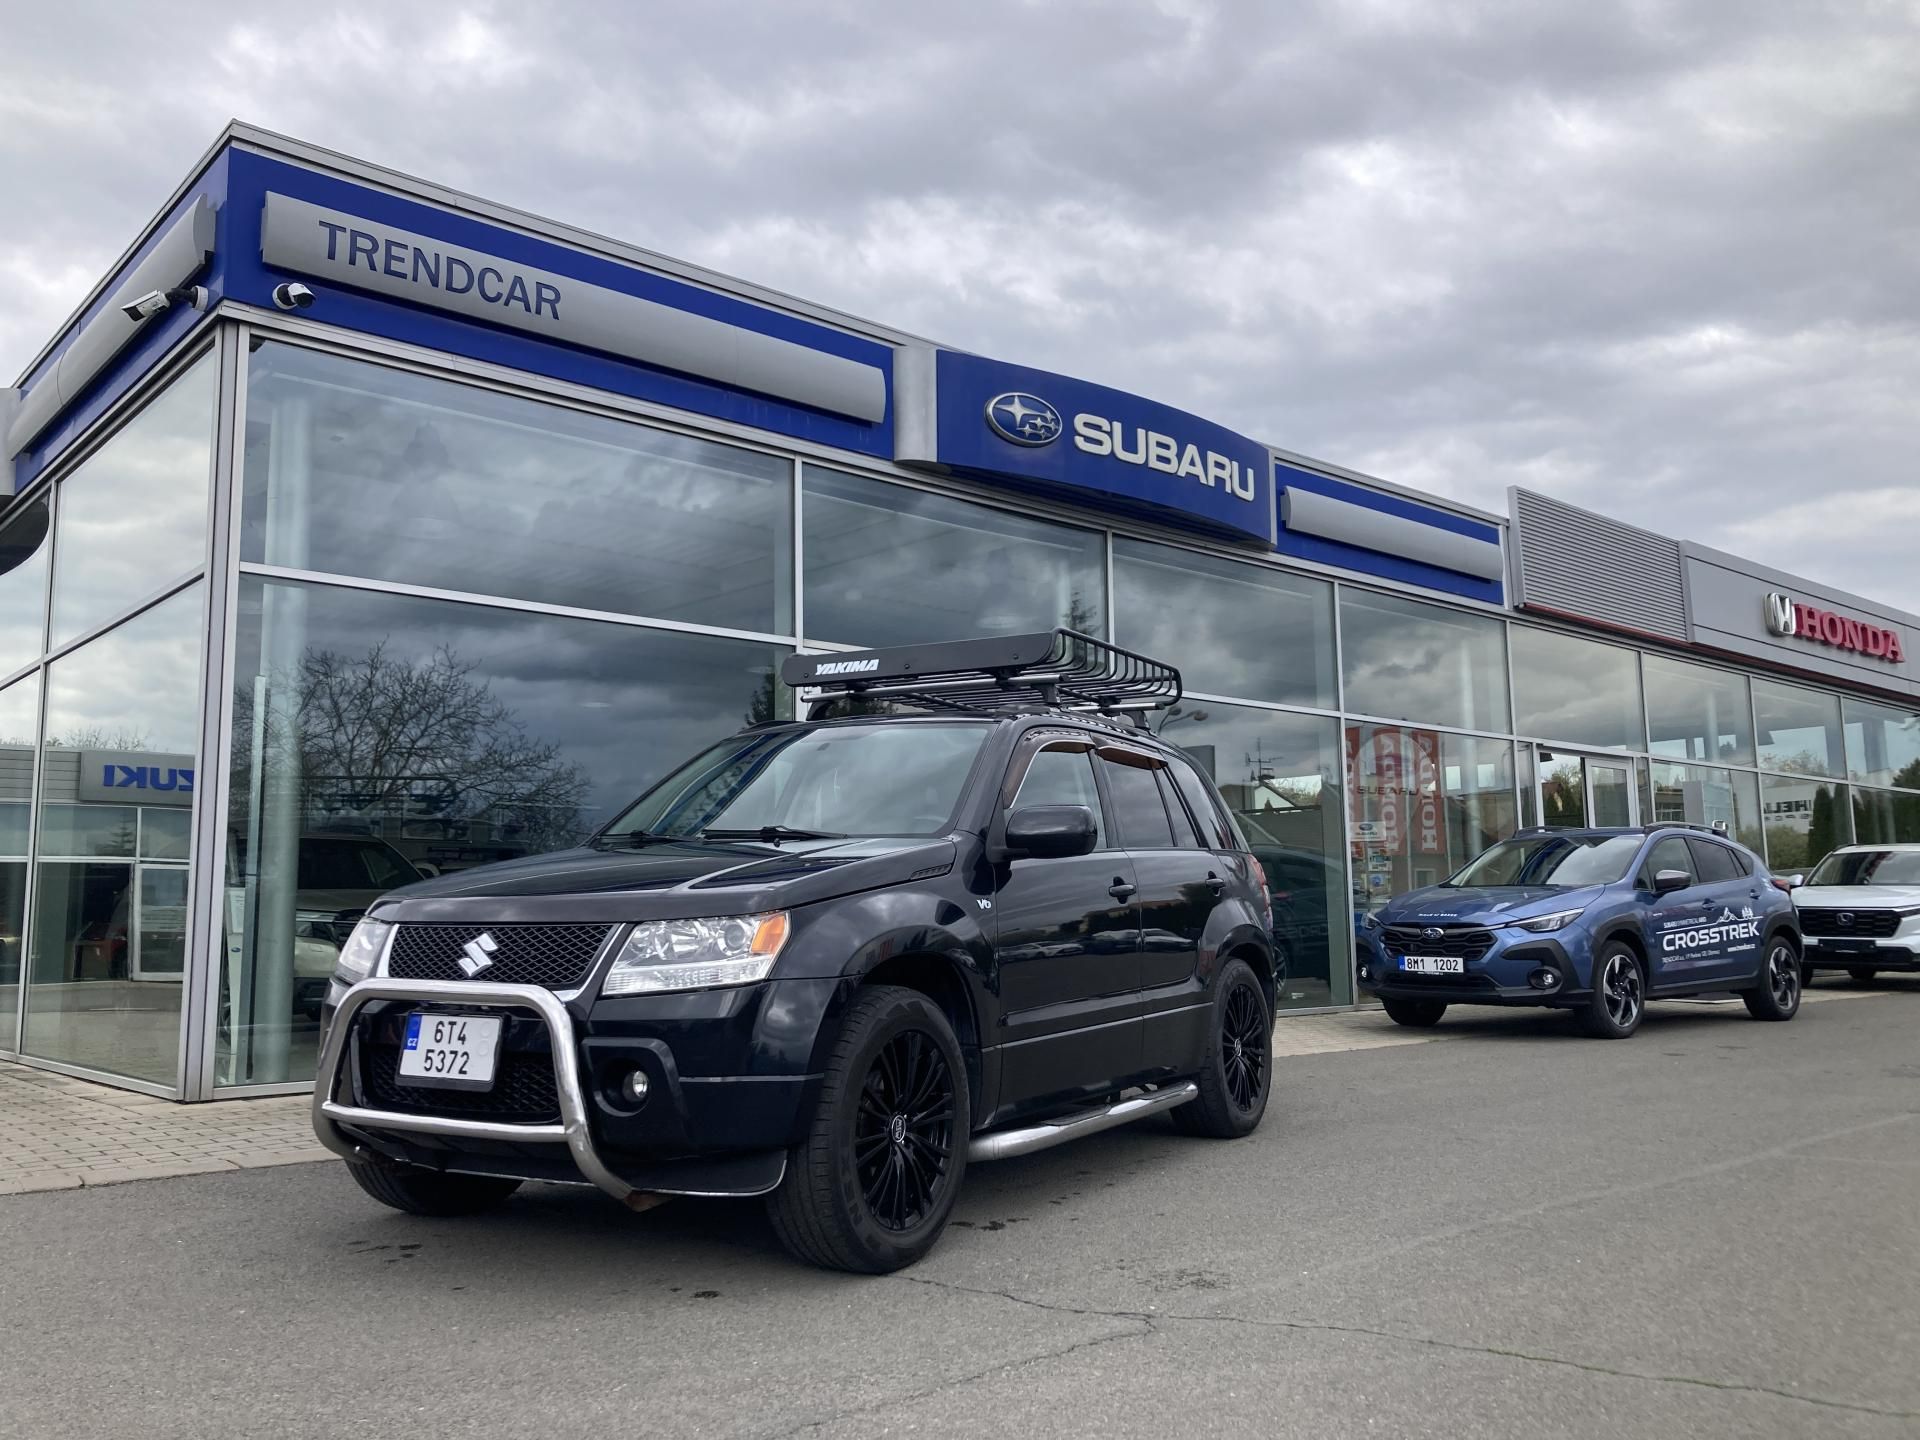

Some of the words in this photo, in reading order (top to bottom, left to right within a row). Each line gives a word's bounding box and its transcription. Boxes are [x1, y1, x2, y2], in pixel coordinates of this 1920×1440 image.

[318, 220, 562, 320] TRENDCAR
[1073, 413, 1255, 502] SUBARU
[1794, 603, 1905, 663] HONDA
[815, 658, 880, 675] YAKIMA
[976, 898, 992, 910] V6
[1662, 921, 1760, 951] CROSSTREK
[1406, 958, 1425, 970] 8M1
[1433, 958, 1459, 971] 1202
[407, 1037, 418, 1047] CZ
[434, 1020, 467, 1045] 6T4
[424, 1048, 470, 1075] 5372
